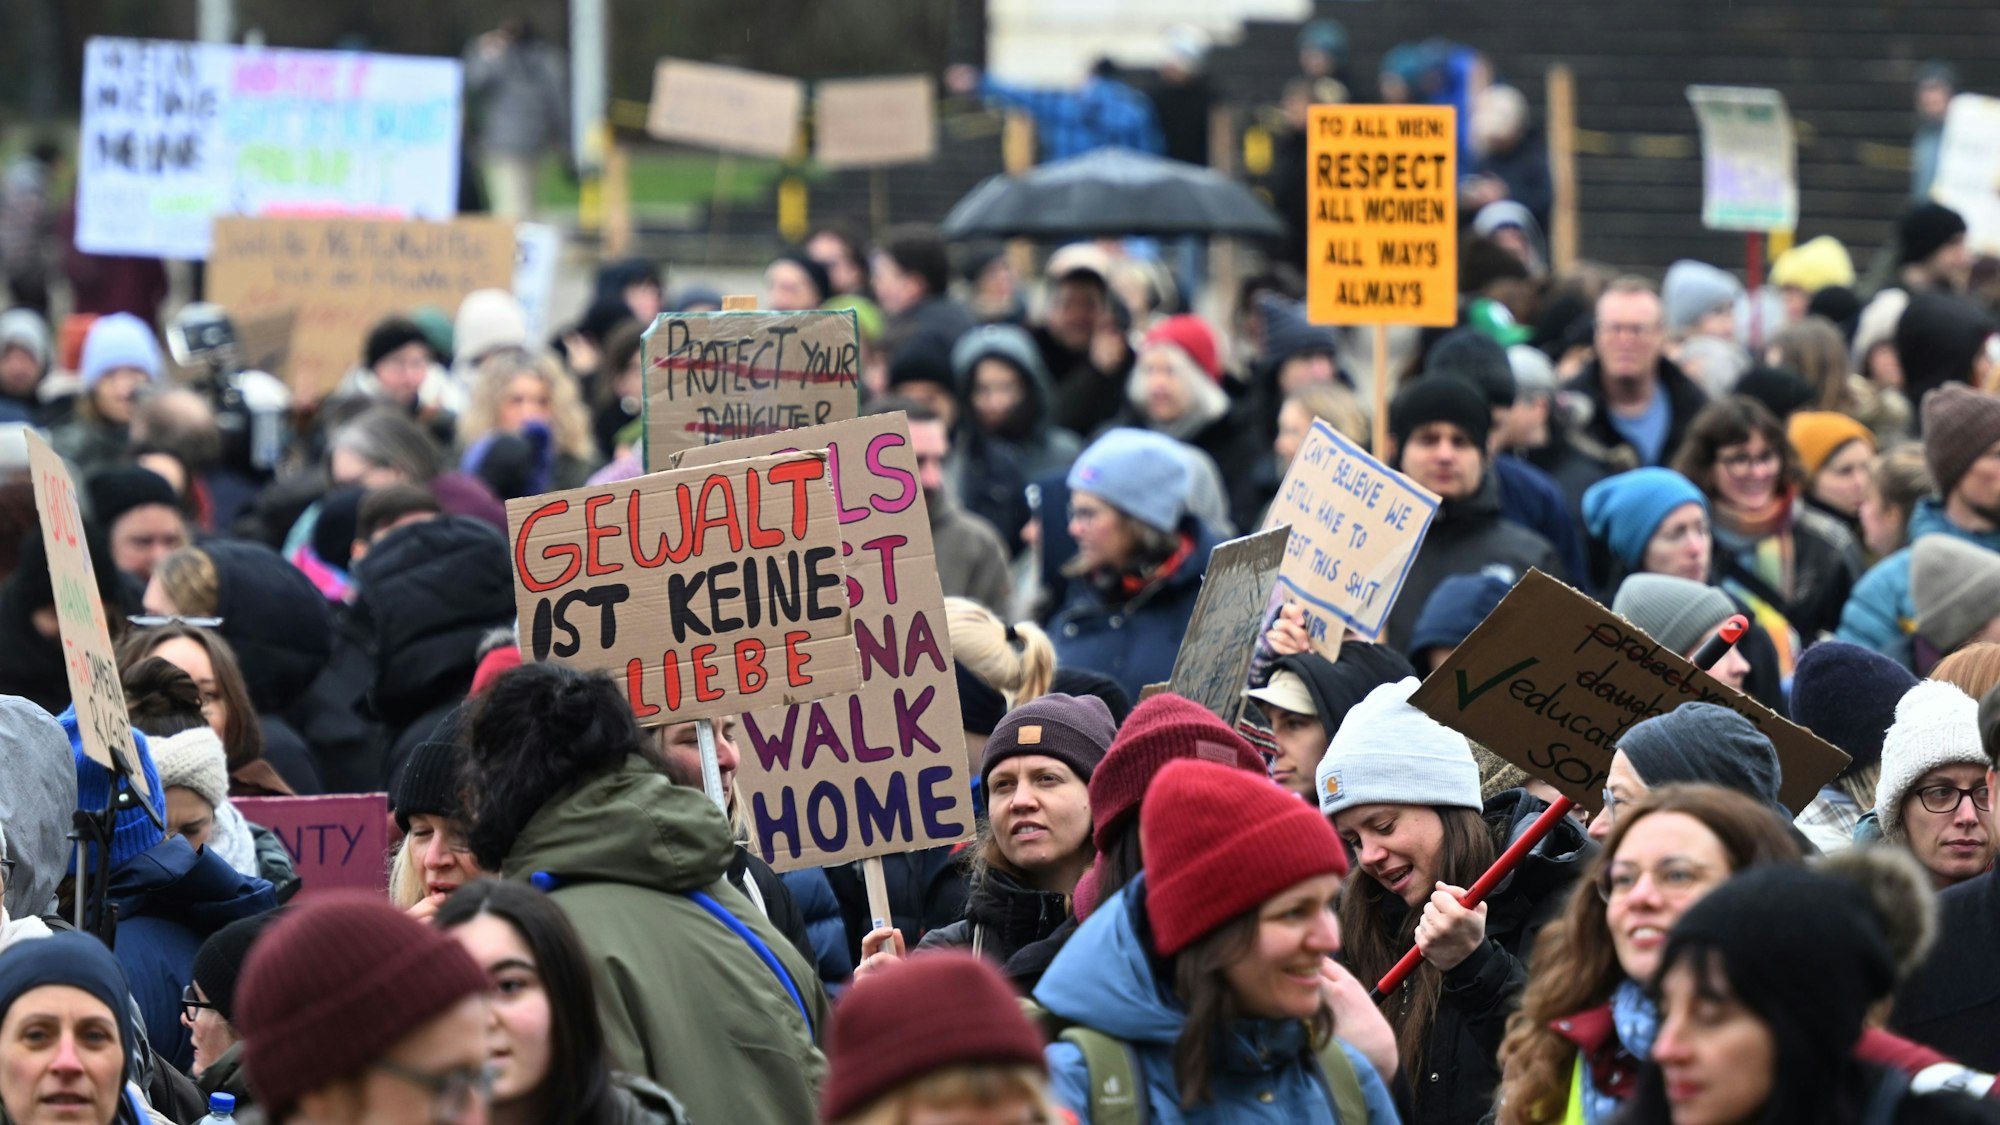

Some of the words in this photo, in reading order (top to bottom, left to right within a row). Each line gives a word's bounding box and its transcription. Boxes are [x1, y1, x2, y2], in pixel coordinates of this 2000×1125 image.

[1319, 116, 1343, 137] TO
[1353, 117, 1388, 137] ALL
[1317, 153, 1446, 190] RESPECT
[1317, 198, 1354, 223] ALL
[1364, 198, 1446, 224] WOMEN
[1325, 240, 1363, 266] ALL
[1378, 240, 1438, 268] WAYS
[1336, 279, 1424, 308] ALWAYS
[668, 319, 798, 401] PROTECT
[801, 339, 859, 389] YOUR
[515, 458, 825, 593] GEWALT
[1315, 500, 1345, 534] HAVE
[1349, 522, 1367, 549] TO
[1331, 458, 1384, 509] BELIEVE
[1383, 496, 1412, 531] WE
[531, 583, 630, 661] IST
[668, 546, 843, 643] KEINE
[1310, 547, 1341, 582] THIS
[1345, 571, 1381, 608] SHIT
[626, 631, 813, 717] LIEBE
[1574, 623, 1699, 694] protect
[742, 685, 941, 772] WALK
[752, 765, 965, 864] HOME
